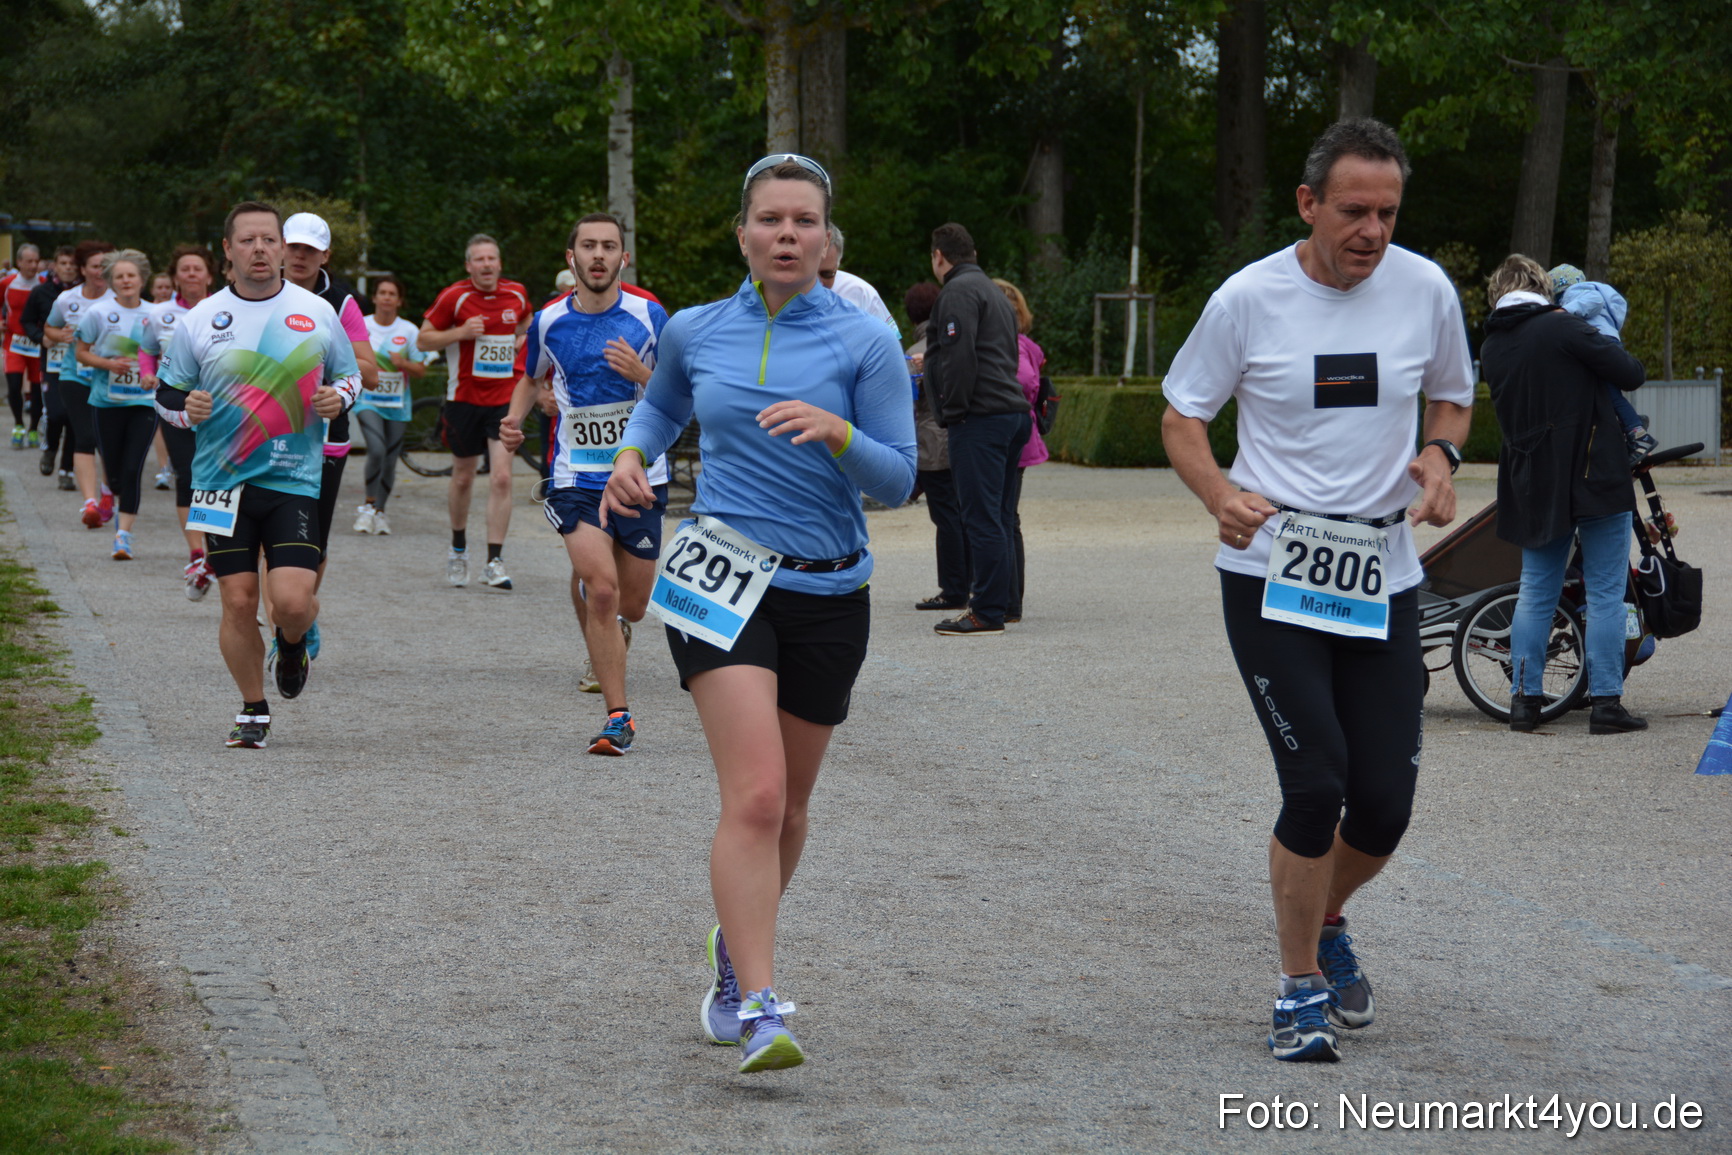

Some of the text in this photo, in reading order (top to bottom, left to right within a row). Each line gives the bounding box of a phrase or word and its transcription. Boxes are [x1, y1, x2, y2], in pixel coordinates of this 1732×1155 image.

[211, 331, 234, 340] PARTL
[114, 370, 141, 385] 261
[376, 380, 400, 393] 637
[590, 408, 624, 419] Neumarkt
[272, 439, 288, 451] 16.
[193, 489, 232, 509] 584
[192, 510, 207, 522] Tilo
[1282, 522, 1377, 549] PARTL Neumarkt
[701, 528, 757, 564] Neumarkt
[665, 535, 755, 607] 2291
[1281, 540, 1382, 596] 2806
[665, 587, 709, 621] Nadine
[1300, 594, 1352, 619] Martin
